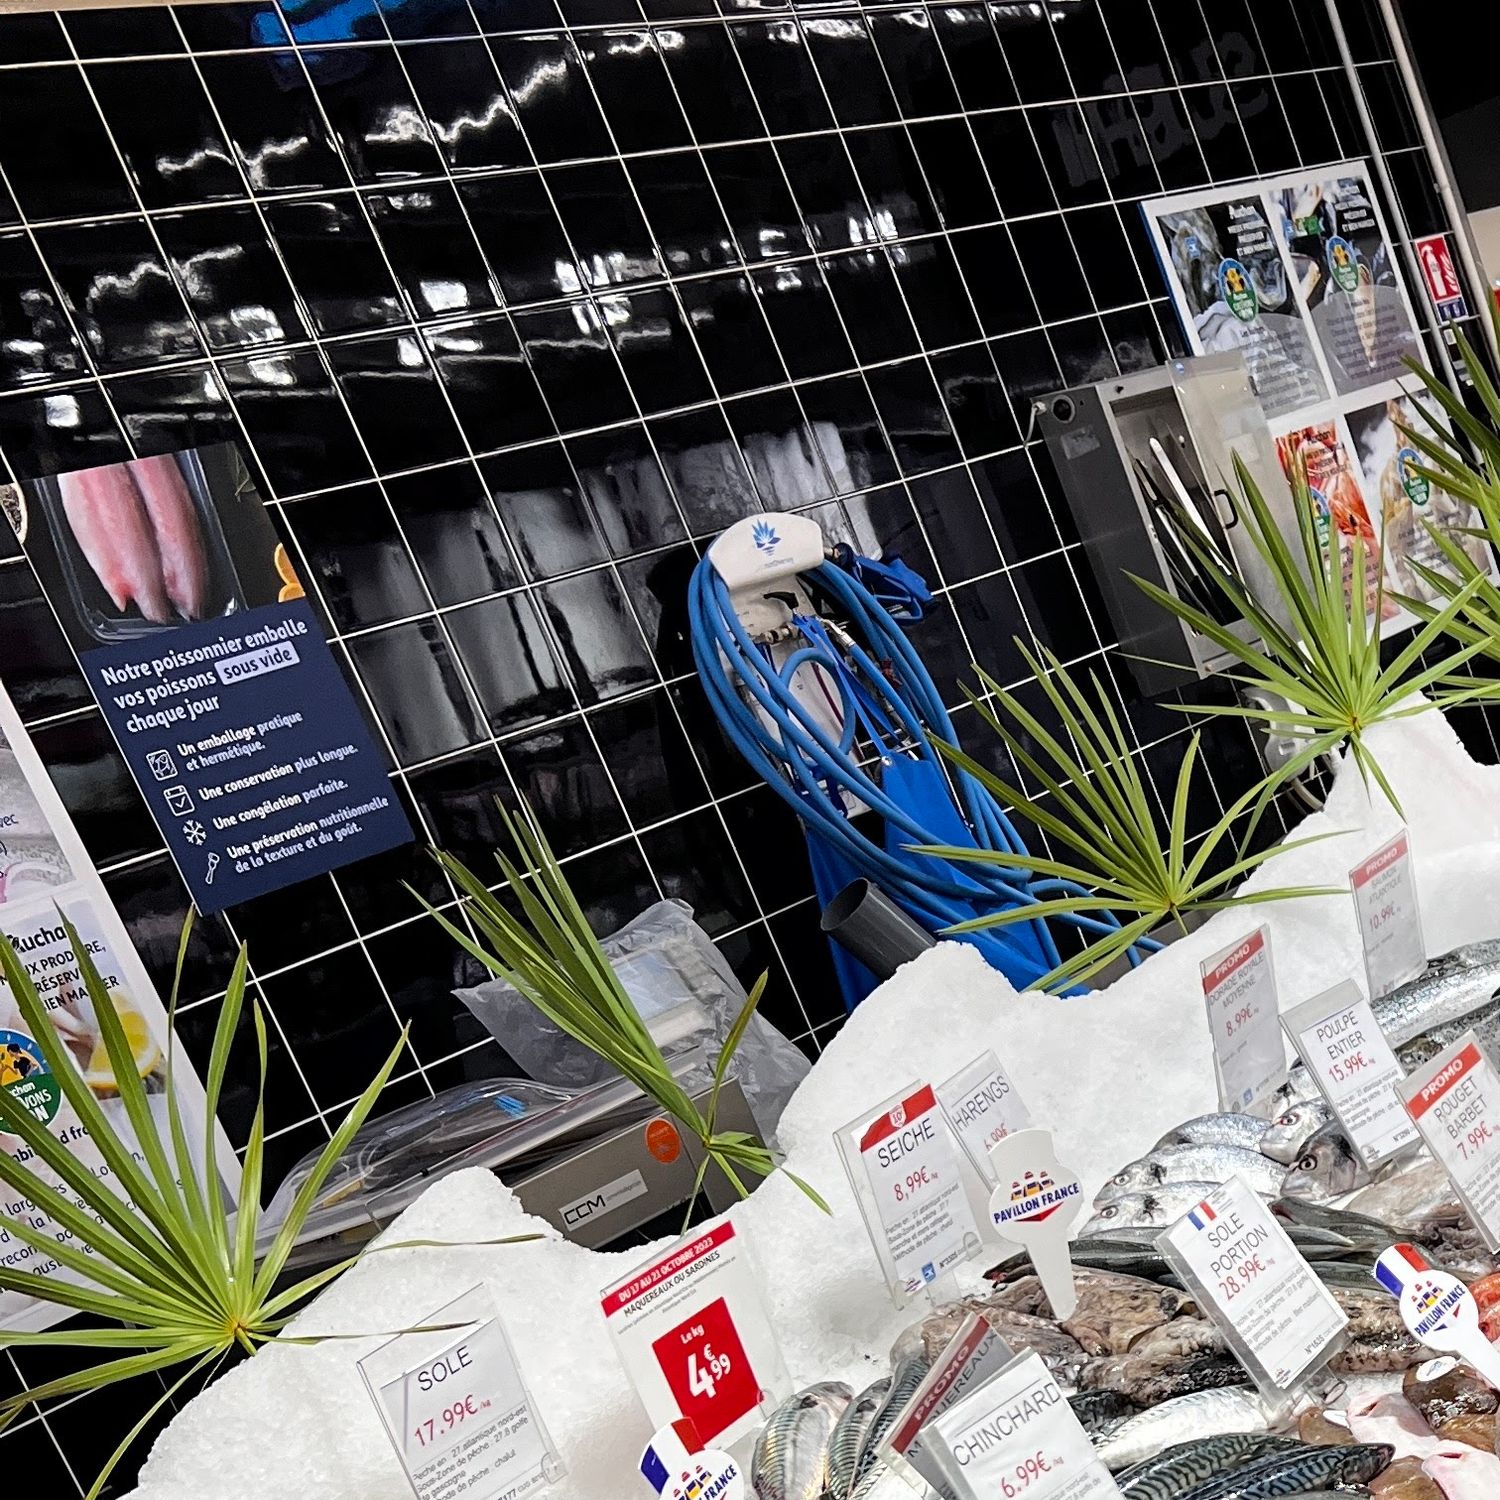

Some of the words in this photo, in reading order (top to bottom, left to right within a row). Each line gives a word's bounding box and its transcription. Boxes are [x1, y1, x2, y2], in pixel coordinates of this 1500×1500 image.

[101, 662, 152, 686] Notre
[152, 636, 242, 677] poissonnier
[245, 619, 308, 648] emballe
[113, 688, 149, 709] vos
[146, 671, 217, 705] poissons
[223, 660, 258, 680] sous
[259, 648, 293, 668] vide
[126, 706, 187, 733] chaque
[184, 695, 220, 721] jour
[177, 742, 197, 757] Un
[197, 725, 256, 751] emballage
[256, 711, 303, 736] pratique
[186, 756, 199, 771] et
[200, 739, 266, 768] hermétique.
[198, 785, 223, 801] Une
[224, 764, 294, 793] conservation
[294, 757, 318, 773] plus
[317, 743, 359, 765] longue.
[212, 814, 238, 830] Une
[238, 794, 302, 820] congélation
[302, 779, 348, 803] parfaite.
[226, 844, 251, 859] Une
[252, 821, 318, 852] préservation
[318, 796, 389, 827] nutritionnelle
[235, 860, 250, 874] de
[251, 854, 264, 869] la
[266, 843, 304, 863] texture
[305, 836, 318, 849] et
[318, 829, 333, 844] du
[335, 821, 363, 842] goût.
[1365, 848, 1398, 876] PROMO
[1215, 943, 1251, 979] PROMO
[1237, 951, 1265, 979] ROYALE
[1222, 976, 1257, 1009] MOYENNE
[1226, 1002, 1254, 1037] 8.99€
[1316, 1010, 1359, 1043] POULPE
[1326, 1030, 1366, 1060] ENTIER
[1328, 1051, 1368, 1084] 15.99€
[1421, 1057, 1464, 1102] PROMO
[1433, 1076, 1479, 1123] ROUGET
[952, 1075, 1010, 1132] HARENGS
[1446, 1095, 1489, 1140] BARBET
[877, 1117, 936, 1169] SEICHE
[1456, 1120, 1493, 1161] 7.99€
[893, 1165, 931, 1204] 8,99€
[993, 1193, 1040, 1224] PAVILLON
[1041, 1182, 1080, 1209] FRANCE
[564, 1194, 606, 1225] CCM
[1208, 1212, 1244, 1249] SOLE
[618, 1290, 632, 1304] DU
[629, 1283, 641, 1297] 17
[639, 1276, 653, 1290] AU
[651, 1270, 662, 1284] 21
[660, 1249, 696, 1276] OCTOBRE
[694, 1237, 714, 1256] 2023
[1210, 1224, 1269, 1279] PORTION
[623, 1280, 674, 1318] MAQUEREAUX
[673, 1272, 686, 1285] OU
[685, 1250, 721, 1278] SARDINES
[1219, 1253, 1266, 1300] 28.99€
[680, 1332, 692, 1344] Le
[690, 1324, 705, 1341] kg
[1414, 1306, 1446, 1338] PAVILLON
[1440, 1284, 1467, 1312] FRANCE
[417, 1344, 473, 1392] SOLE
[414, 1394, 478, 1447] 17.99€
[952, 1382, 1062, 1468] CHINCHARD
[1000, 1450, 1052, 1499] 6.99€
